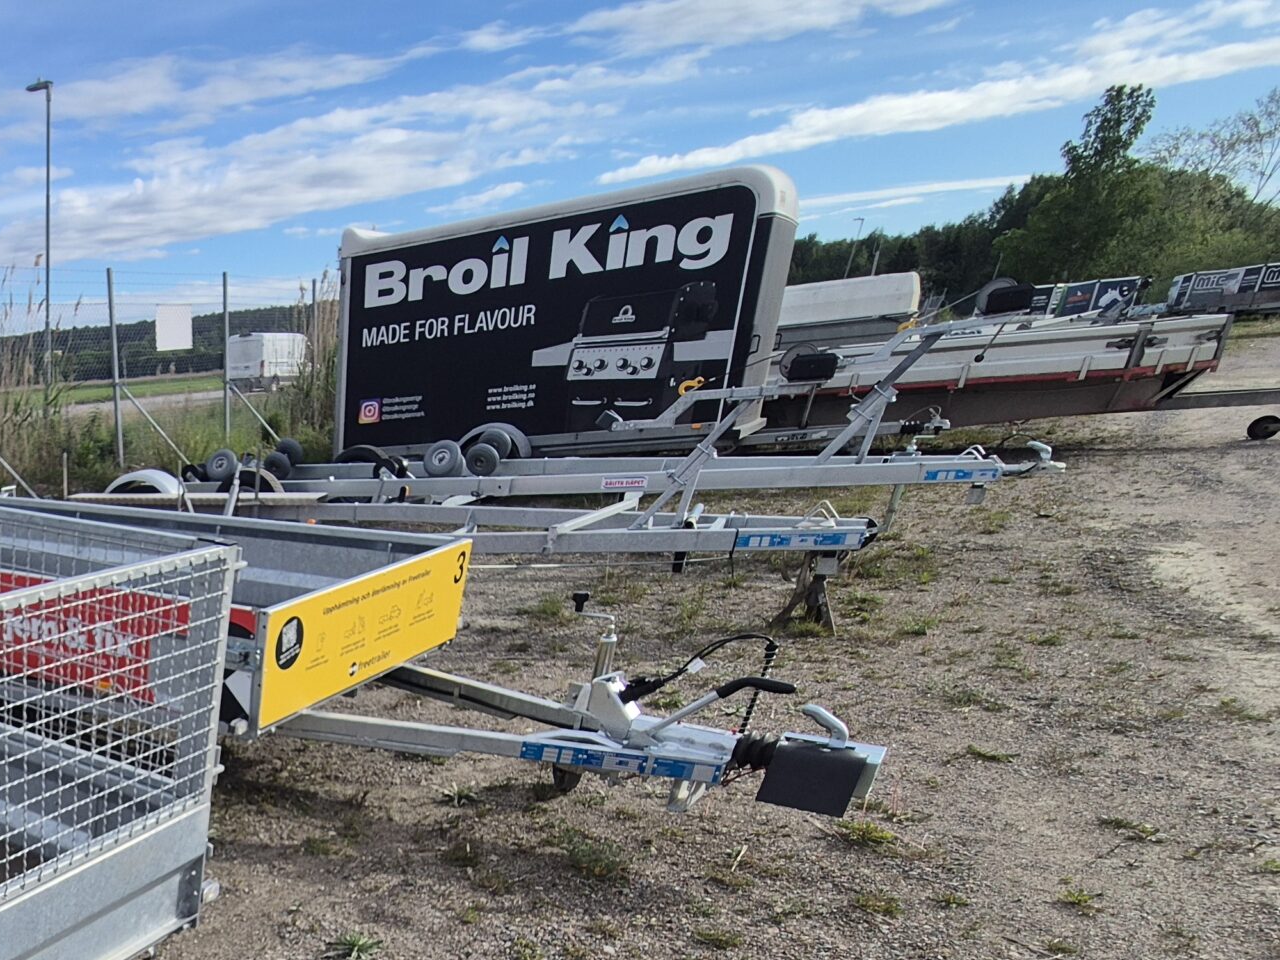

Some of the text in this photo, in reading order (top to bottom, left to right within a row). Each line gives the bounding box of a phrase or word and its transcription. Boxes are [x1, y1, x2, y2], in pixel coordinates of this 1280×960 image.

[363, 213, 735, 309] Broil King
[361, 304, 536, 348] MADE FOR FLAVOUR
[453, 550, 467, 584] 3
